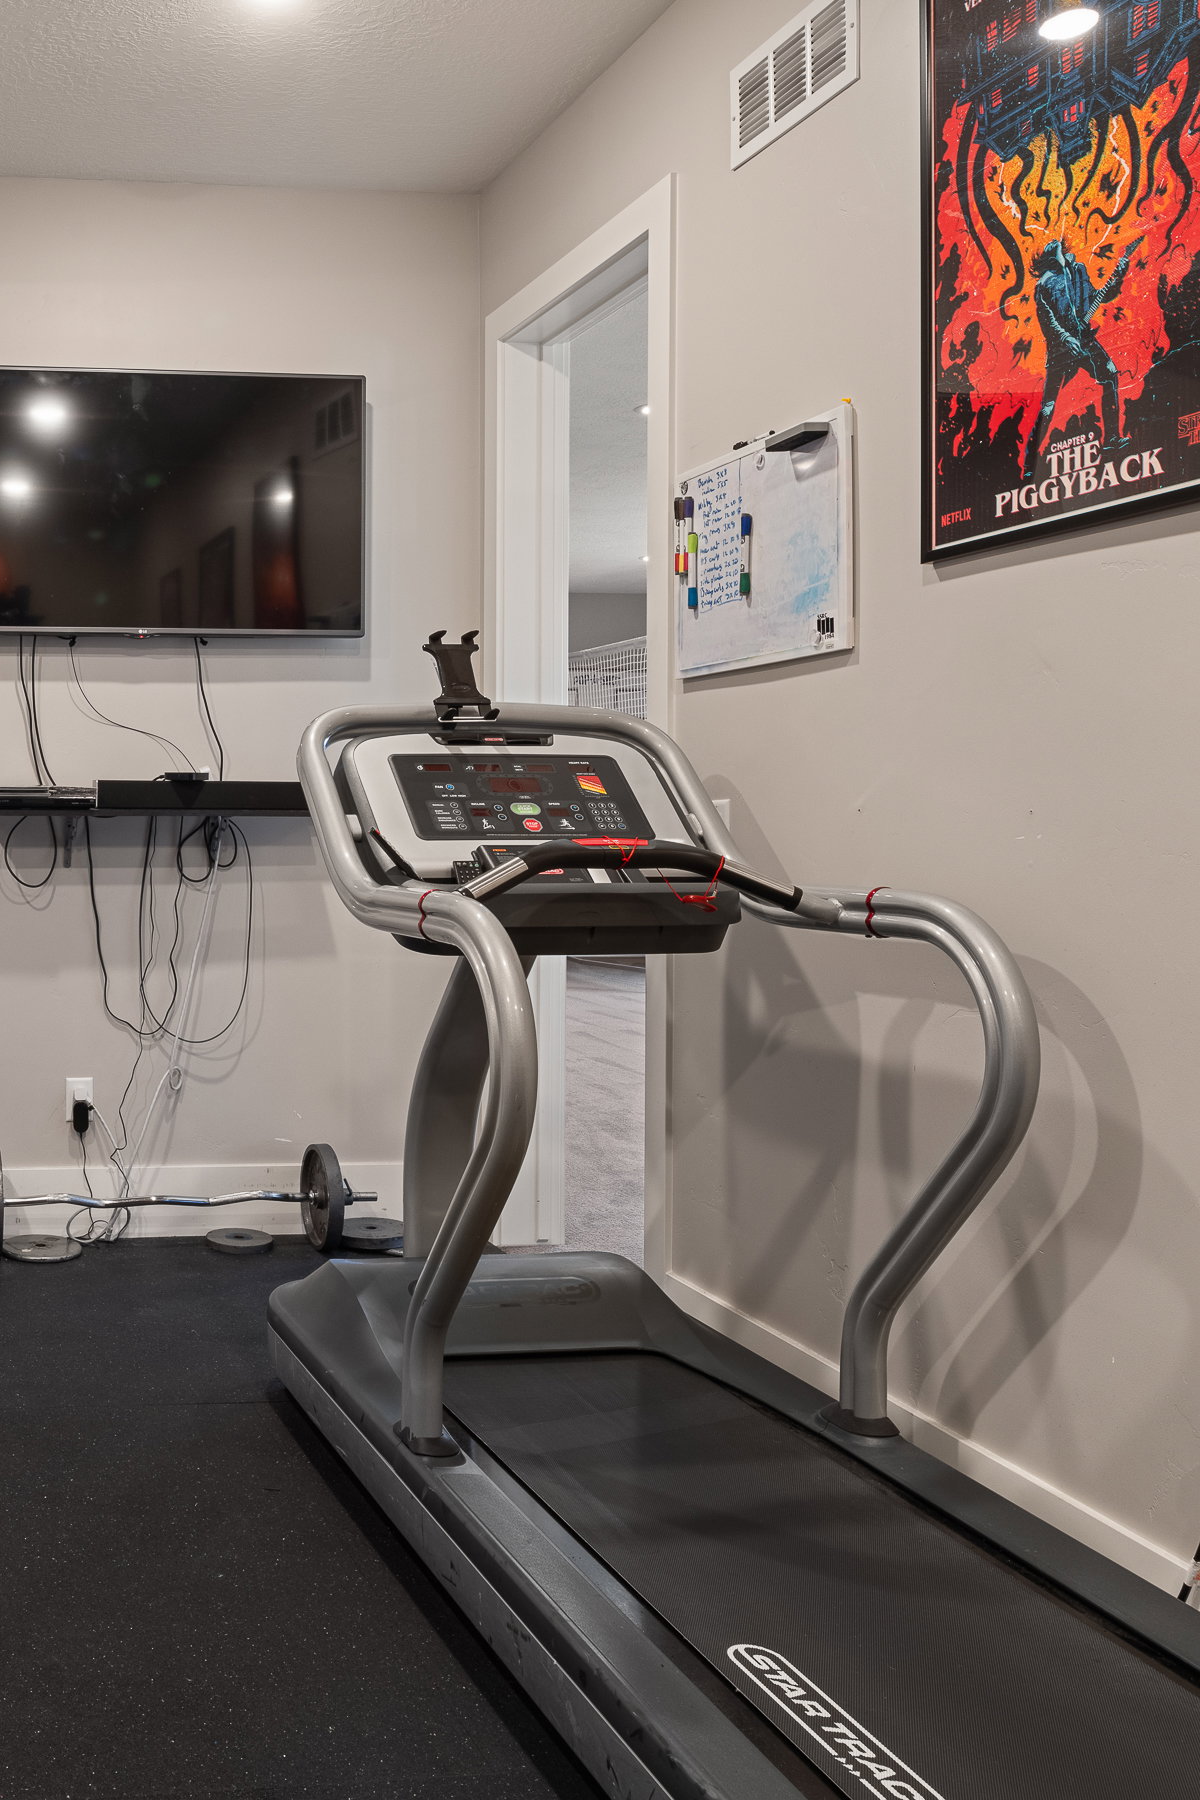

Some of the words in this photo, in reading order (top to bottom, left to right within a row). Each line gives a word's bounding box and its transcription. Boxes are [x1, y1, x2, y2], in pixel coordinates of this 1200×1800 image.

[1046, 440, 1102, 478] THE
[1050, 434, 1086, 452] CHAPTER
[1088, 431, 1095, 441] 9
[994, 447, 1166, 518] PIGGYBACK
[941, 508, 971, 527] NETFLIX
[751, 1653, 831, 1718] STAR
[821, 1721, 926, 1800] TRAC
